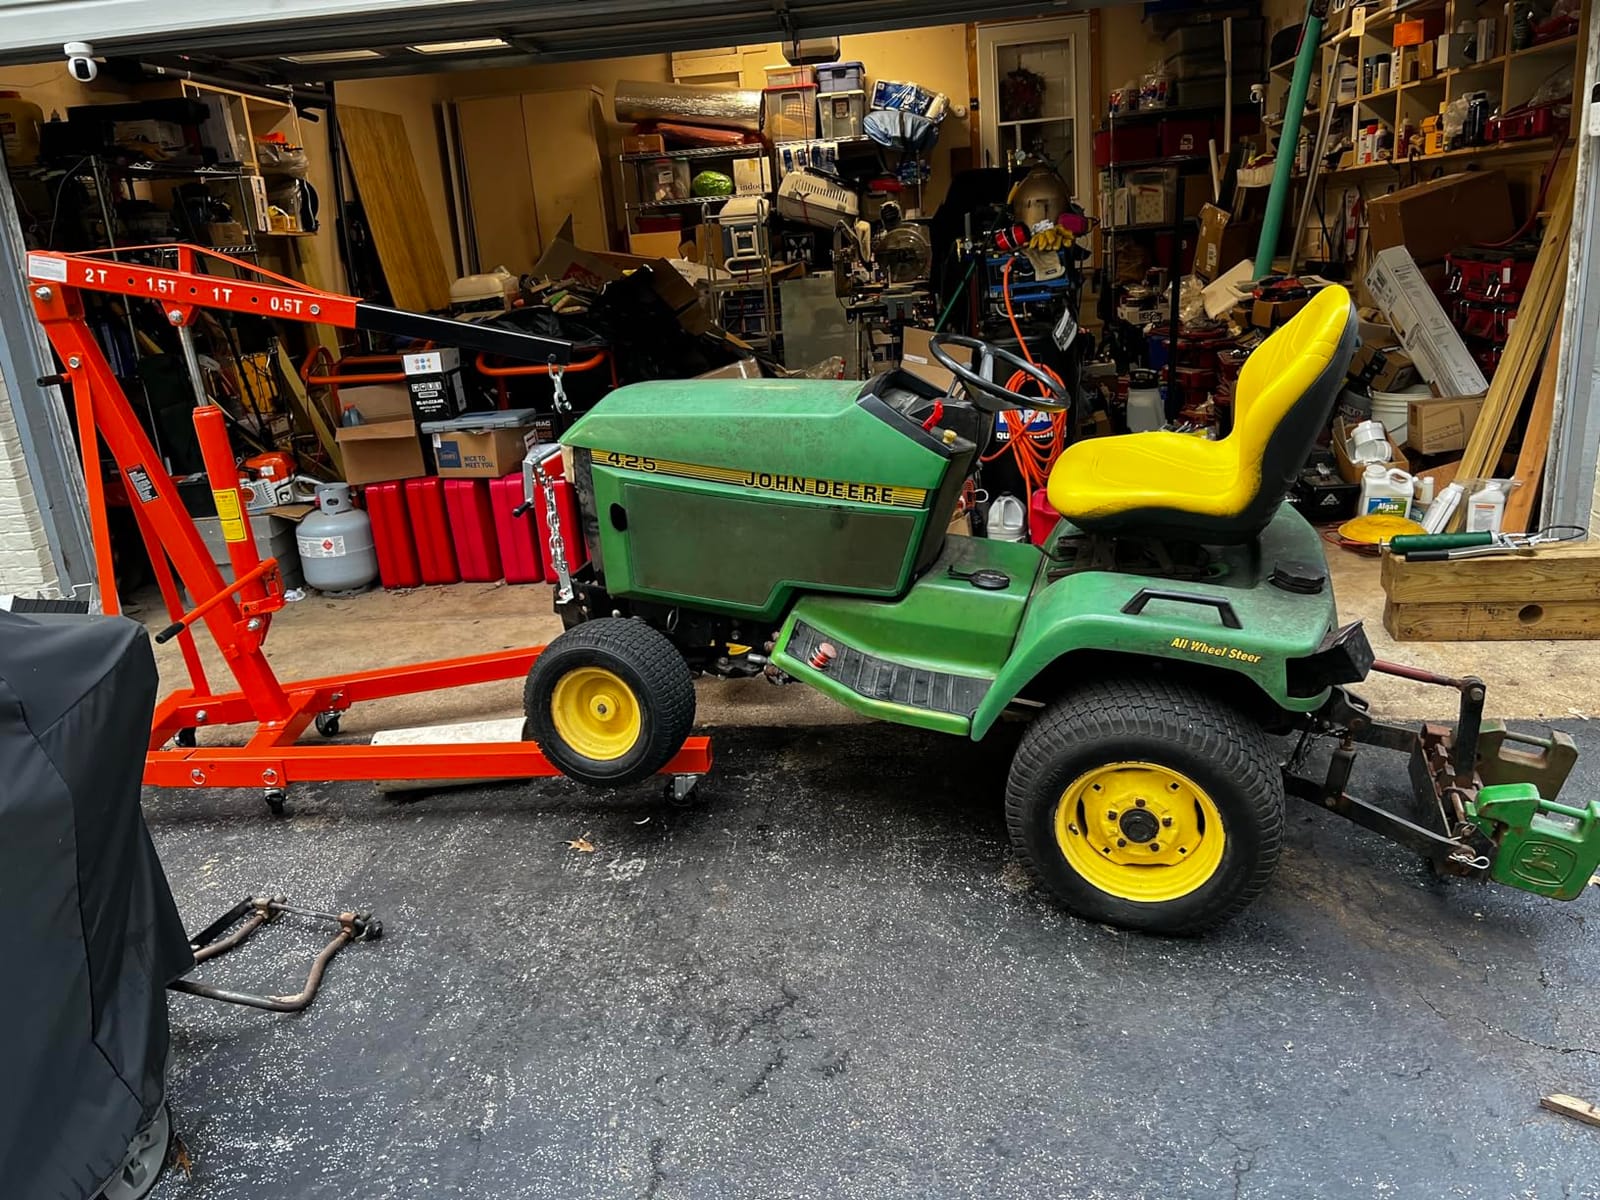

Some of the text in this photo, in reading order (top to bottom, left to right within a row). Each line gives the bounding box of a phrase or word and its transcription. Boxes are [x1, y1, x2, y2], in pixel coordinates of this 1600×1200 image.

[146, 276, 177, 294] 1.5T
[270, 296, 303, 315] 0.5T
[607, 451, 657, 472] 425
[744, 471, 894, 504] JOHN DEERE
[1377, 502, 1399, 512] Algae
[1170, 637, 1261, 664] All Wheel Steer
